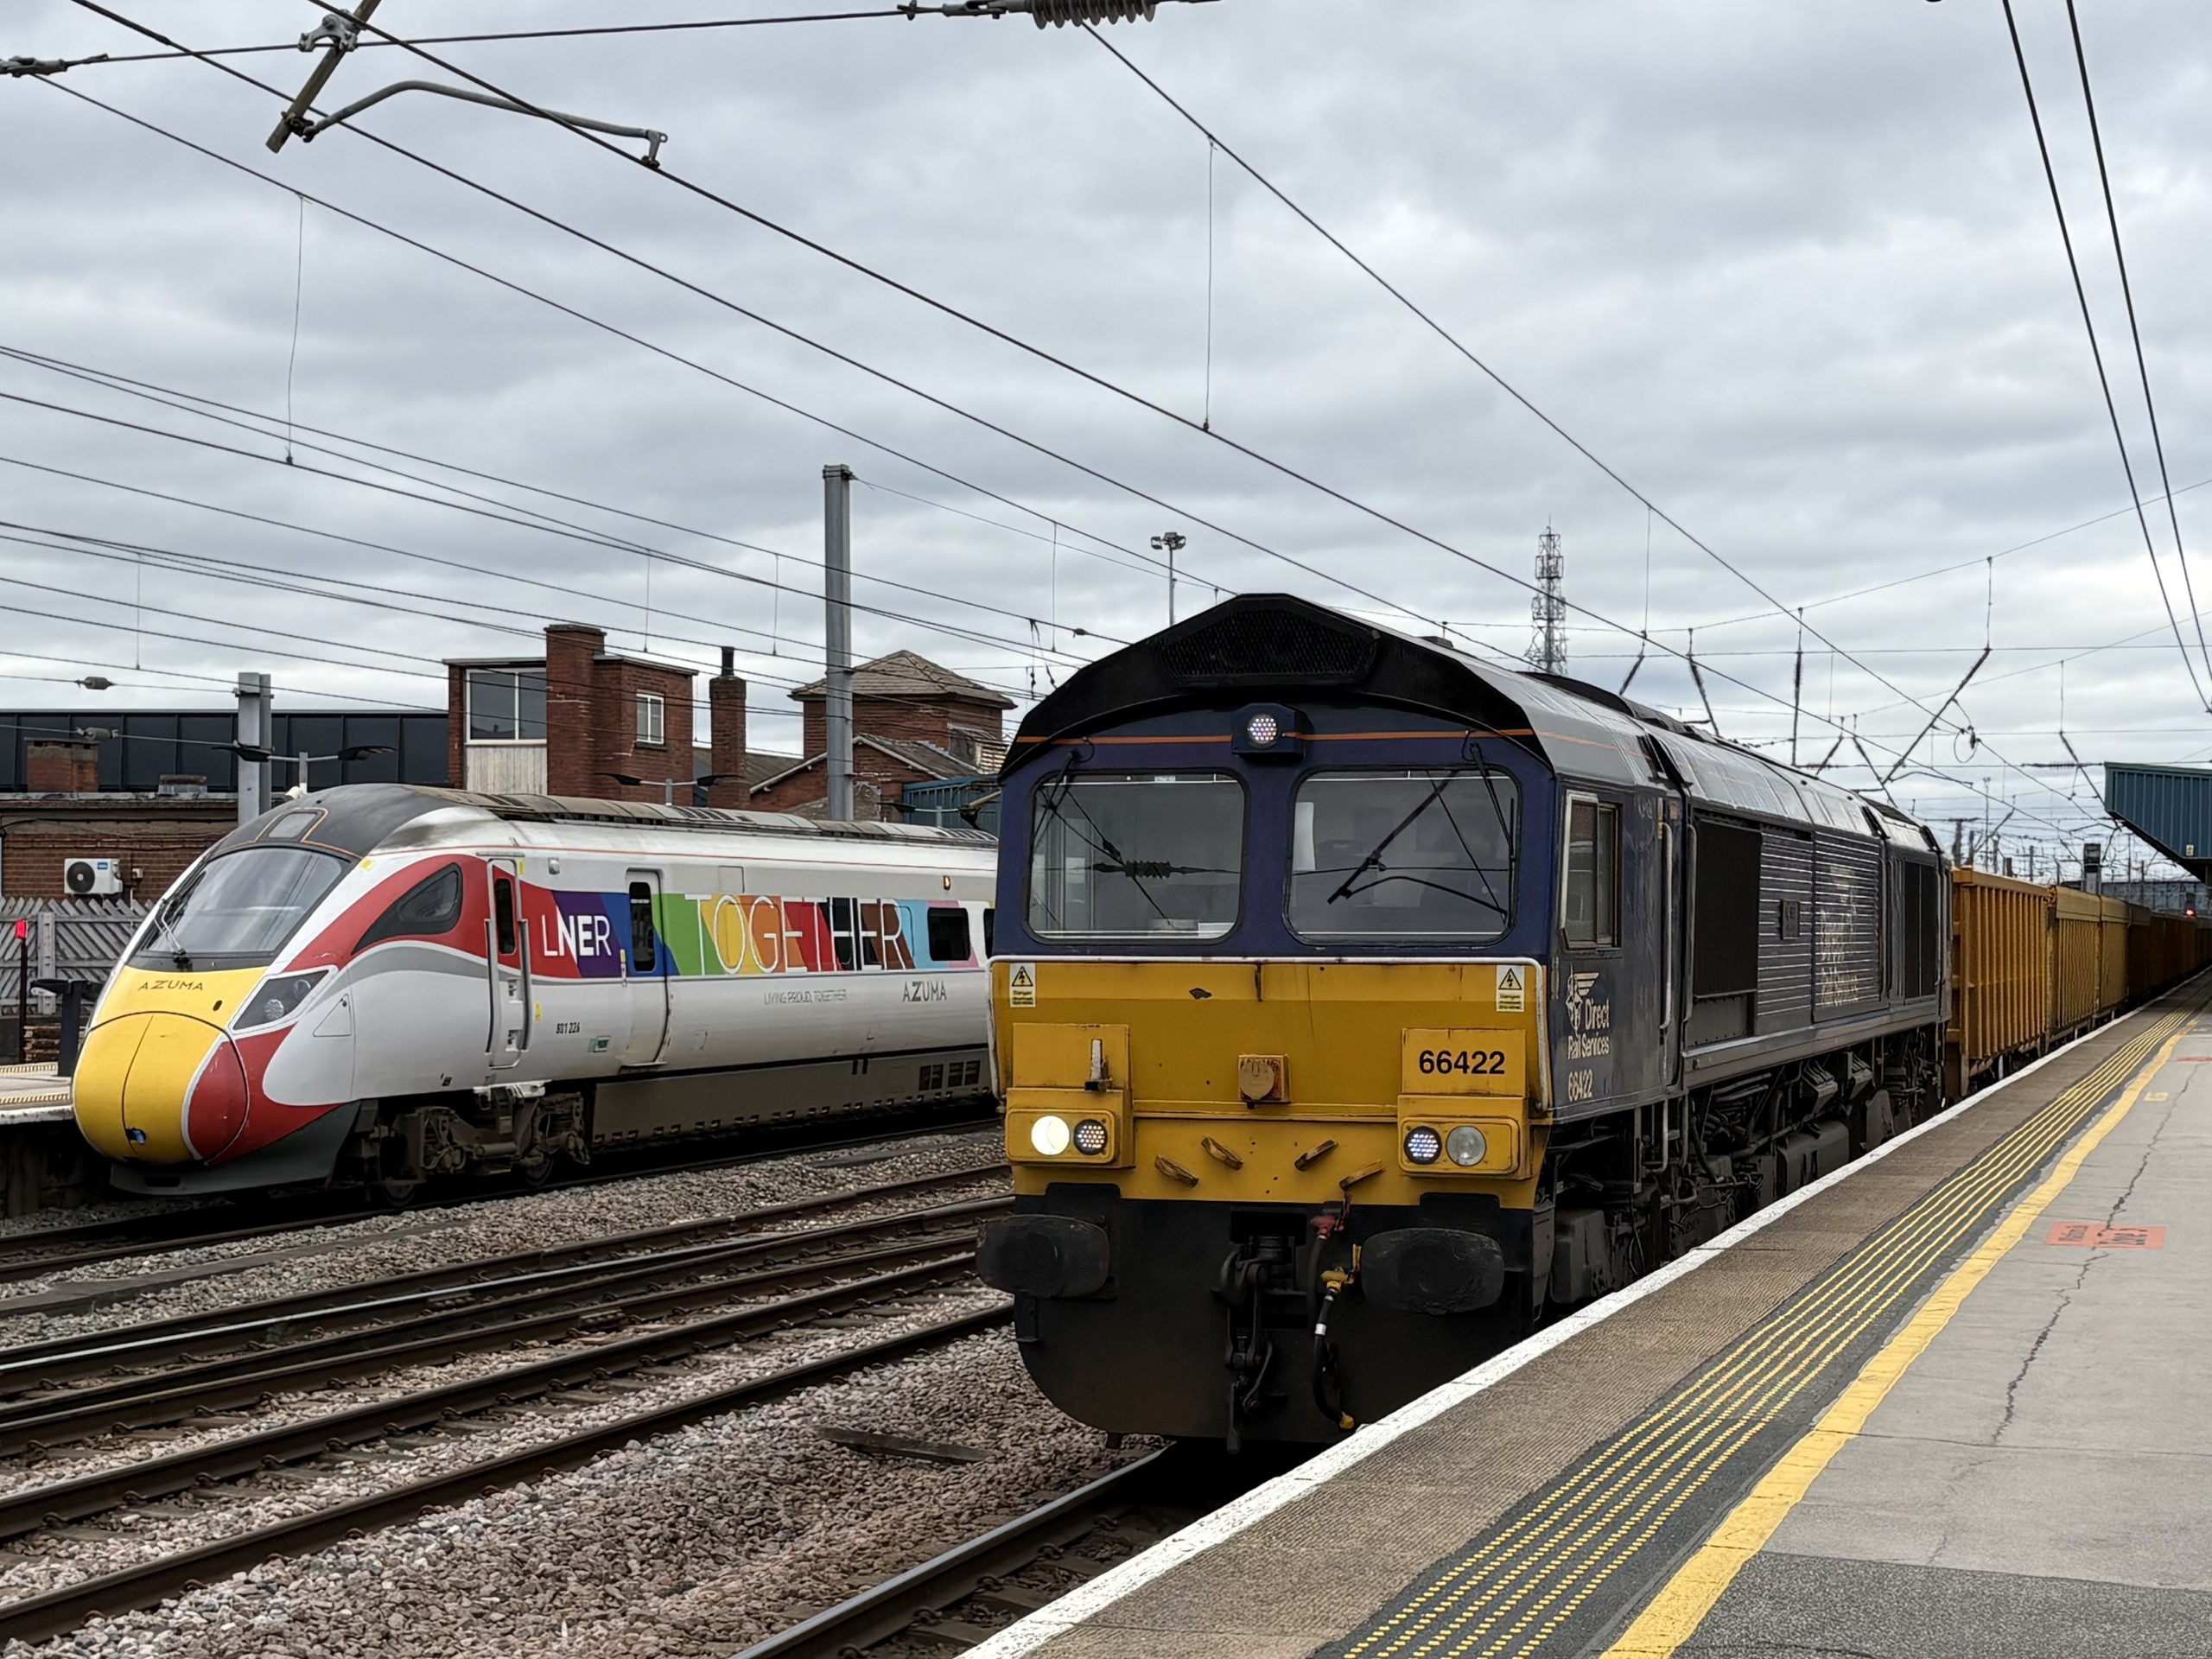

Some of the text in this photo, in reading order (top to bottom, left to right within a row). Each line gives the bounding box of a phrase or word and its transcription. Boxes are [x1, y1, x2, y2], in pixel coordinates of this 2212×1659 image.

[542, 906, 612, 965] LNER
[684, 893, 906, 976] TOGETHER
[137, 980, 203, 991] AZUMA
[902, 981, 948, 1002] AZUMA
[1585, 997, 1610, 1031] Direct
[1582, 1032, 1610, 1058] Services
[1419, 1050, 1505, 1074] 66422
